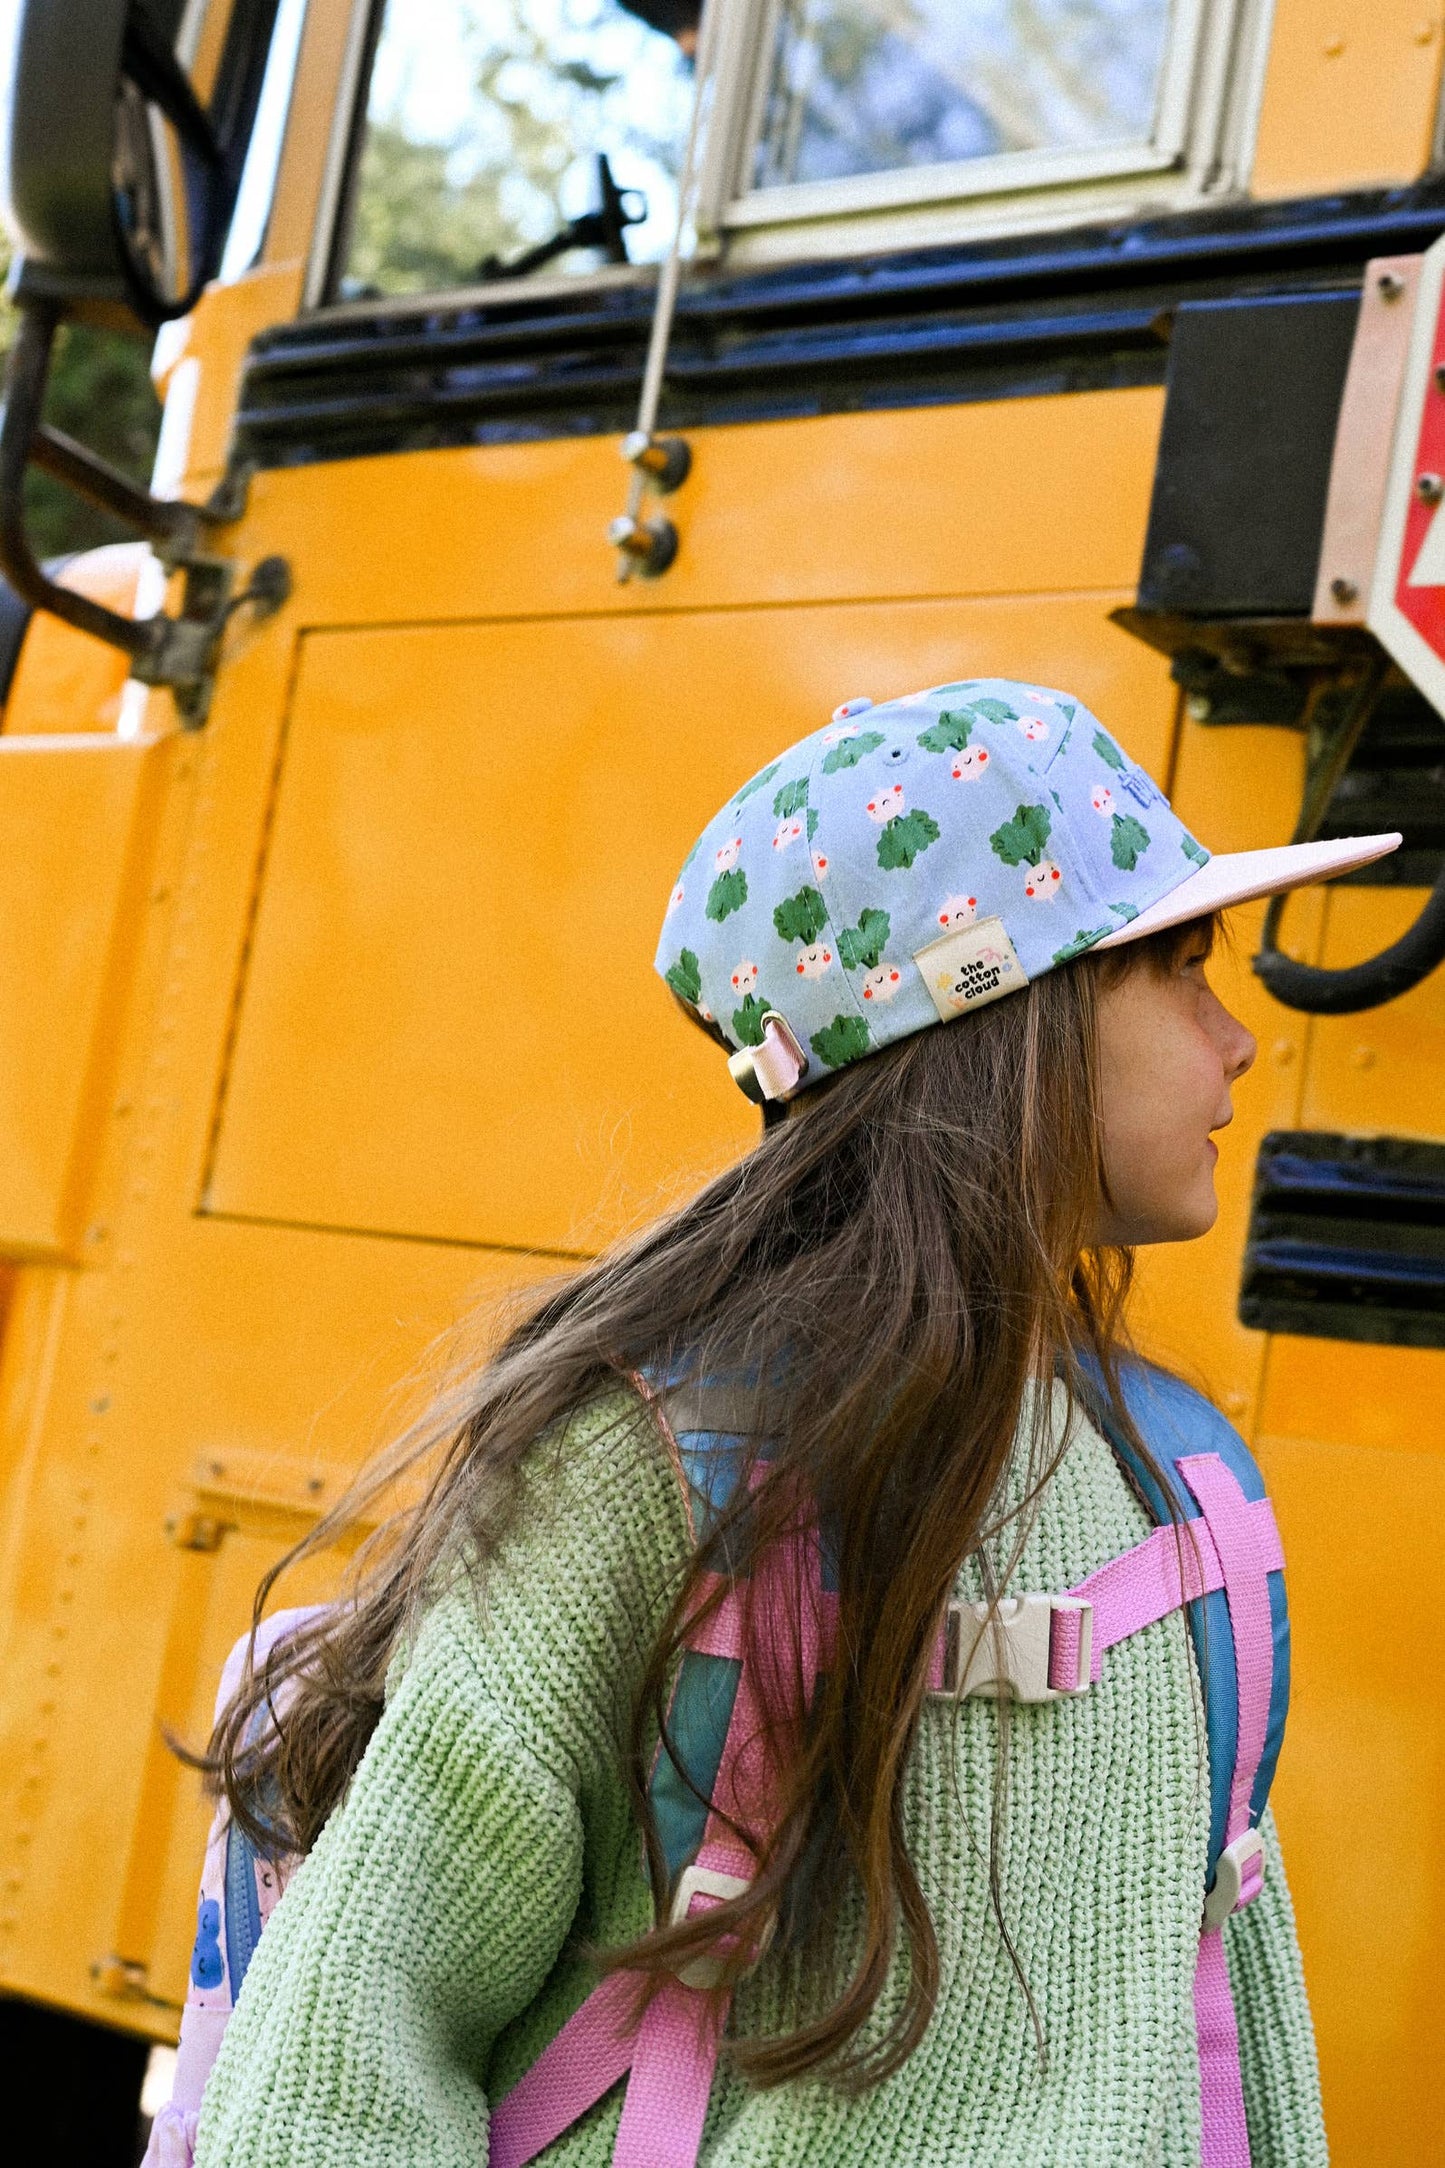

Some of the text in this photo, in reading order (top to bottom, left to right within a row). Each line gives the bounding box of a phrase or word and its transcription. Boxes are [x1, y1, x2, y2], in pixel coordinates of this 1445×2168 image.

[955, 966, 1001, 993] cotton
[960, 960, 984, 976] the
[964, 976, 1000, 999] cloud
